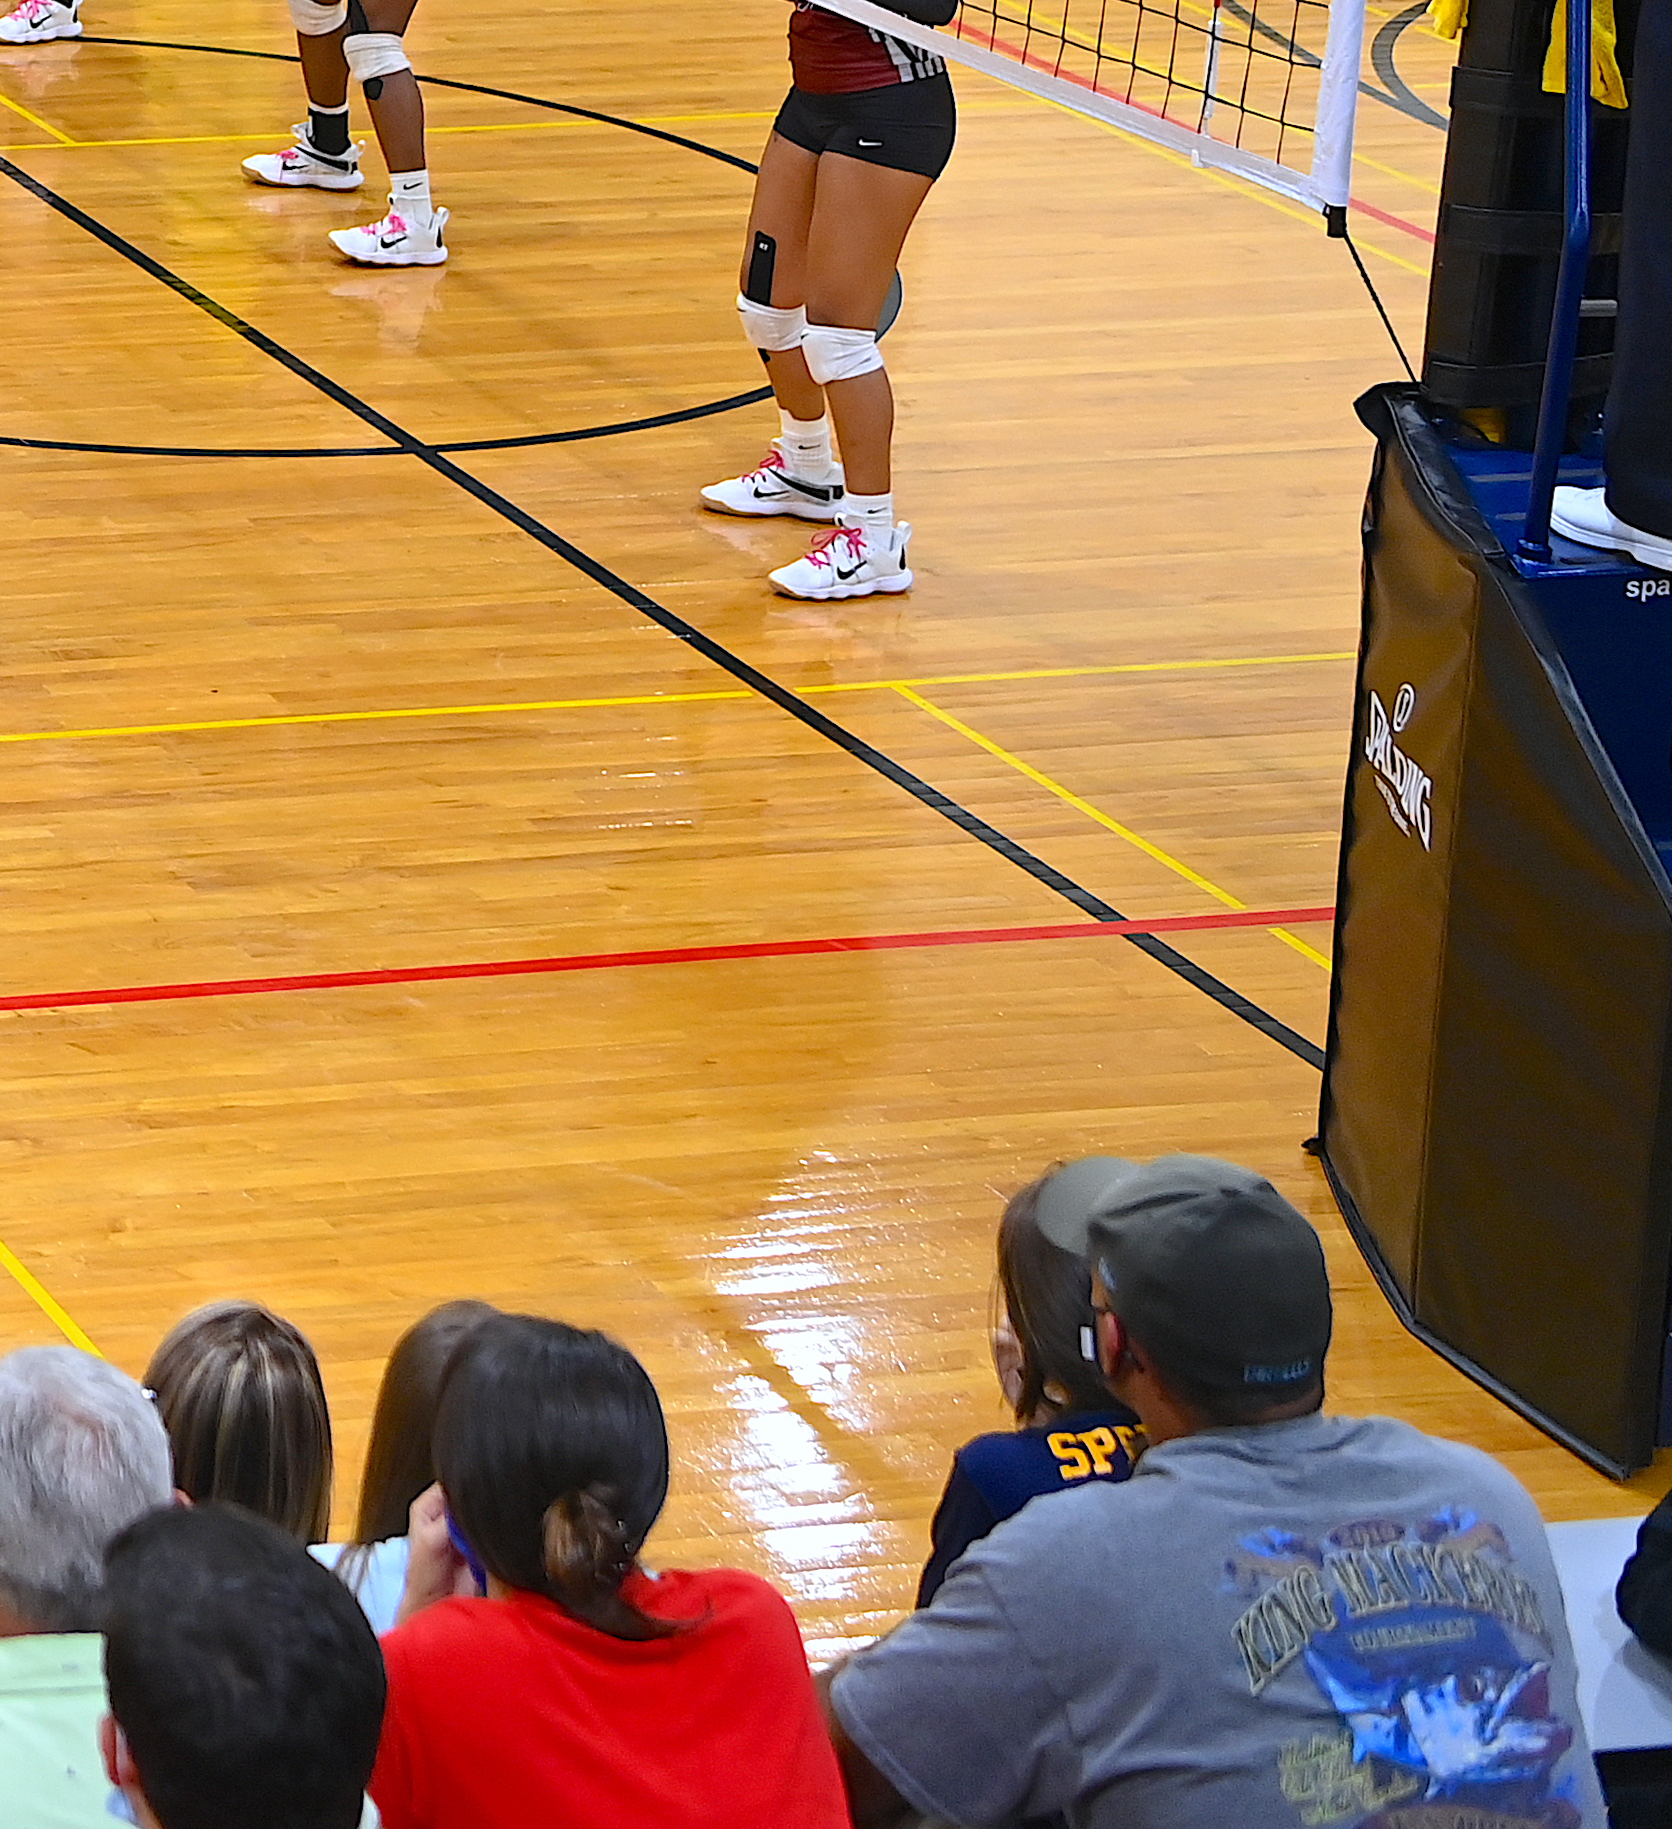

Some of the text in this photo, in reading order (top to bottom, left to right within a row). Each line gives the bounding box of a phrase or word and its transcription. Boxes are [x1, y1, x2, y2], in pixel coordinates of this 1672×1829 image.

[1625, 579, 1671, 603] spa
[1365, 689, 1432, 854] SPALDING
[1231, 1563, 1338, 1698] KING
